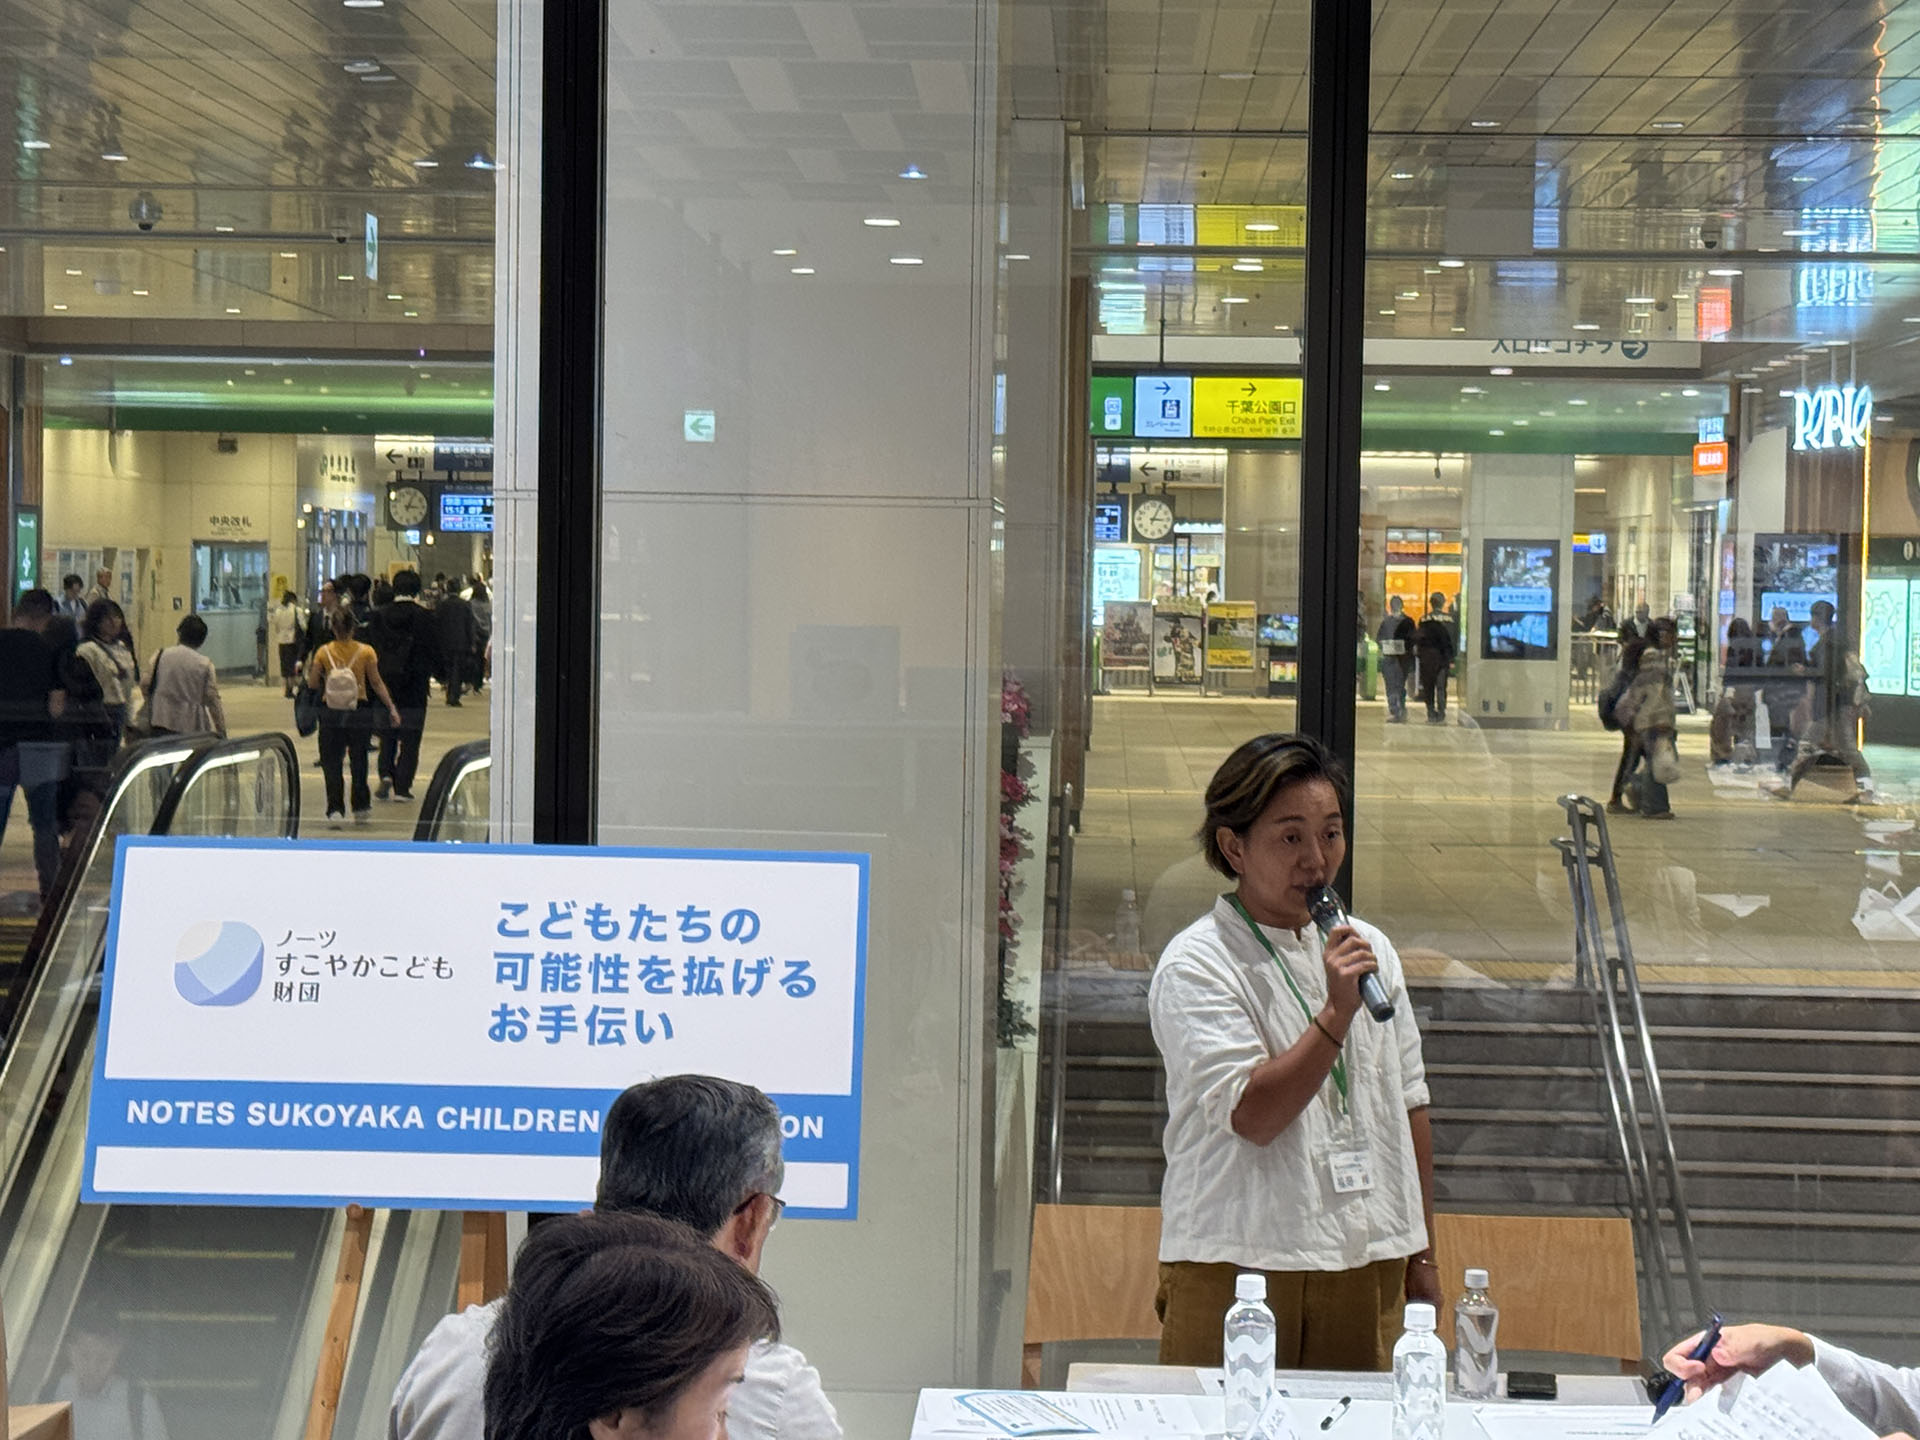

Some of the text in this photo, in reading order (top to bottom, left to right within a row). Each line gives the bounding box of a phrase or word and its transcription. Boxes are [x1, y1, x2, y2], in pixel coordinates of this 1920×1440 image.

[1226, 400, 1296, 414] 千葉公園口
[1231, 416, 1296, 425] Chiba Park Exit
[209, 514, 252, 528] 中央改札
[496, 900, 761, 945] こどもたちの
[276, 930, 337, 948] ノーツ
[275, 954, 454, 979] すこやかこども
[493, 951, 817, 998] 可能性を拡げる
[272, 981, 320, 1003] 財団
[488, 1002, 674, 1047] お手伝い
[126, 1100, 599, 1134] NOTES SUKOYAKA CHILDREN
